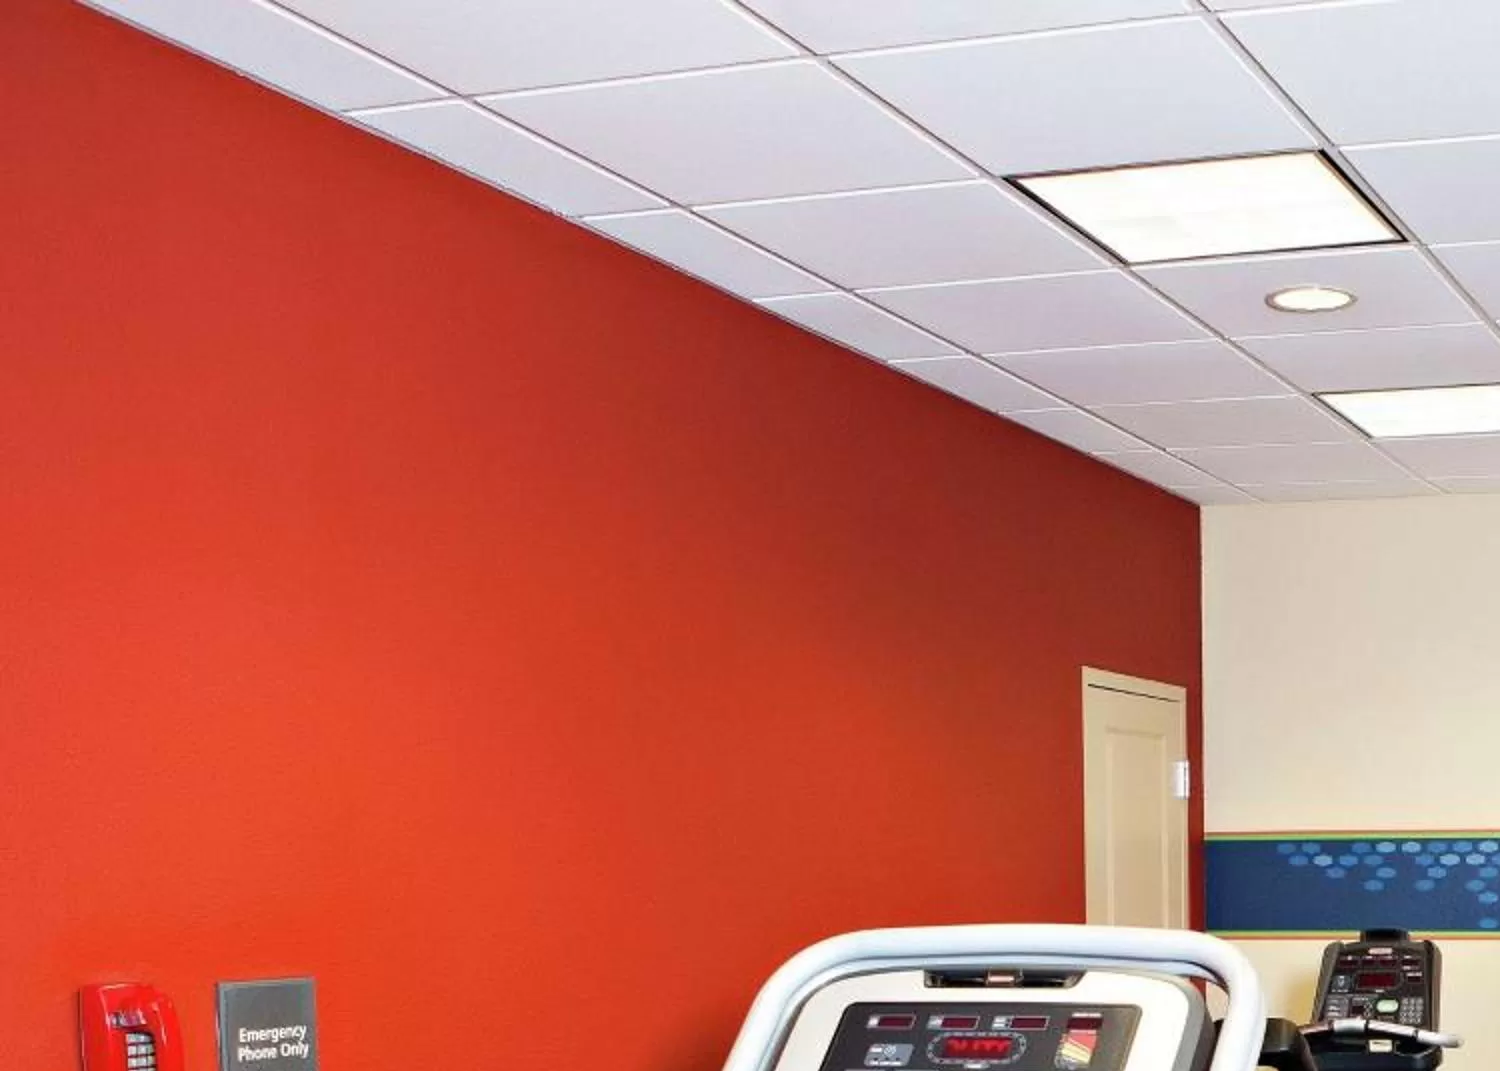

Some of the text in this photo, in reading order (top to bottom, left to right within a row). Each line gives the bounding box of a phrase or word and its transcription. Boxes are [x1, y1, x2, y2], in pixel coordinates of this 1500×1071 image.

[239, 1025, 307, 1043] Emergency
[238, 1041, 309, 1062] Phone Only
